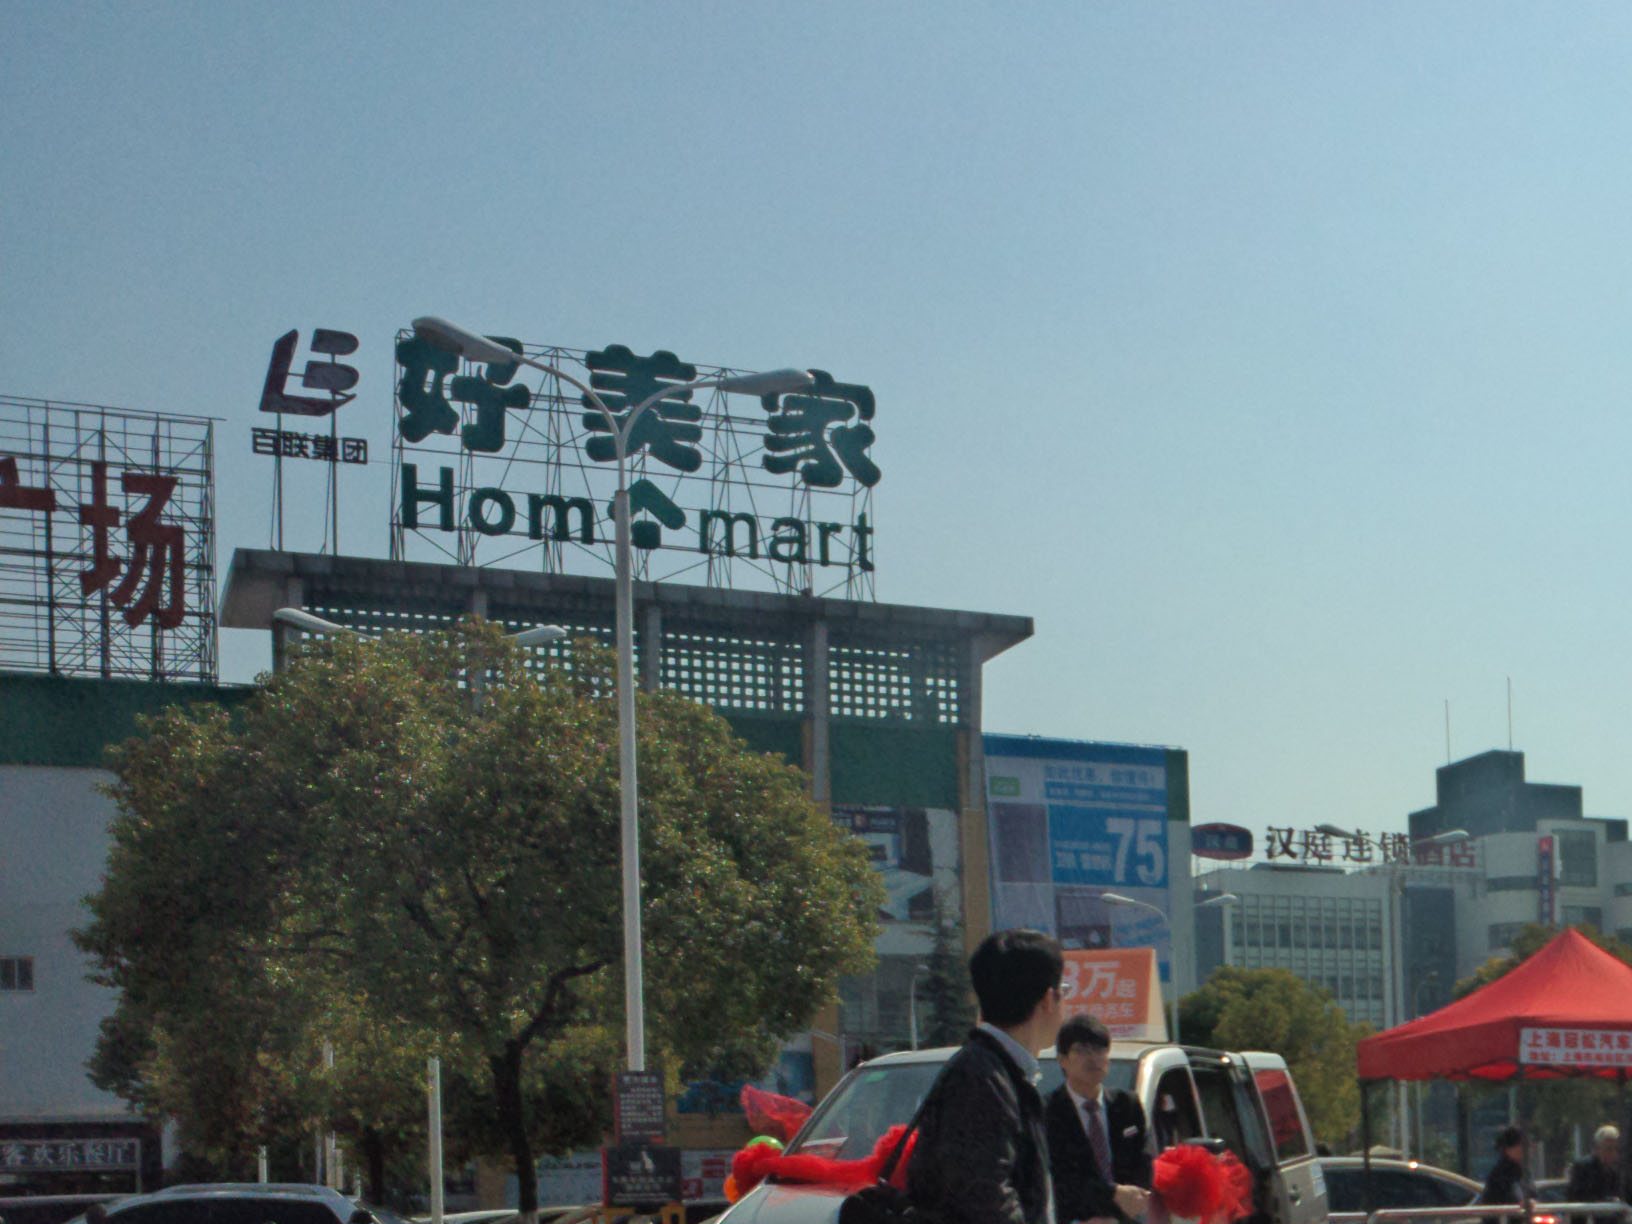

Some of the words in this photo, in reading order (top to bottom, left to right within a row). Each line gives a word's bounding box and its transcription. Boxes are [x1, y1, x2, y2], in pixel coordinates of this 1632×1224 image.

[397, 335, 882, 488] 好美家
[251, 427, 368, 465] 百联集团
[1106, 817, 1165, 886] 75
[1264, 824, 1477, 867] 汉庭连锁酒店
